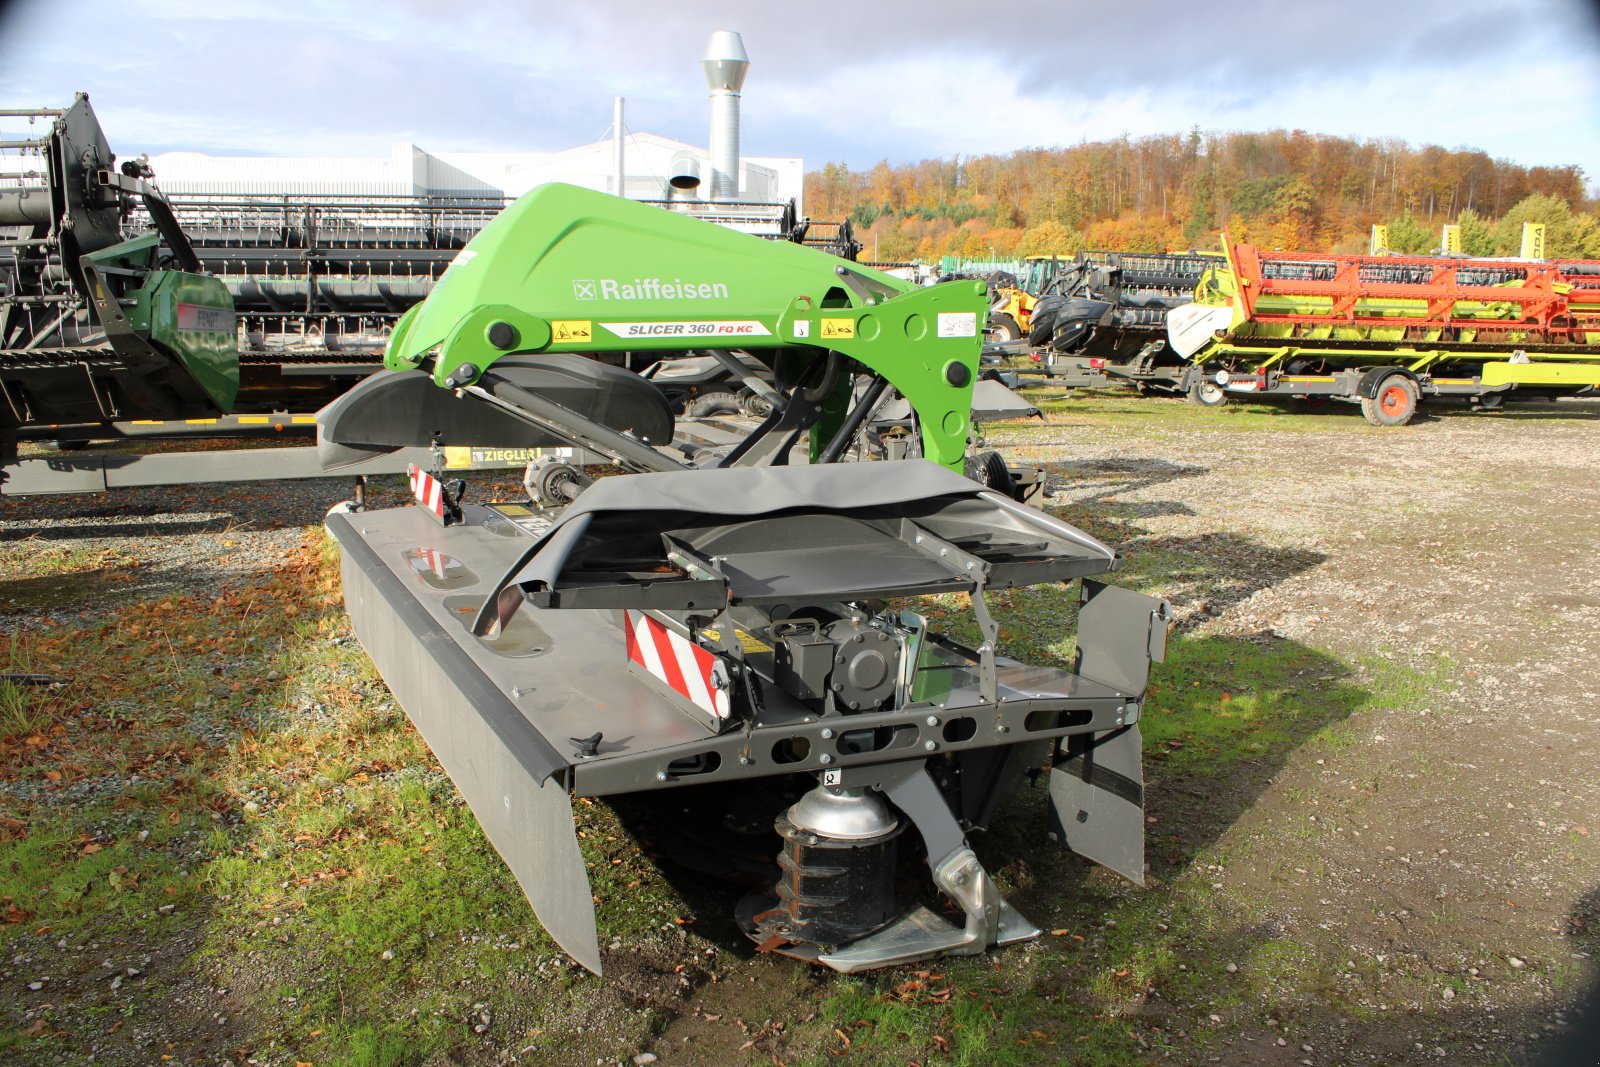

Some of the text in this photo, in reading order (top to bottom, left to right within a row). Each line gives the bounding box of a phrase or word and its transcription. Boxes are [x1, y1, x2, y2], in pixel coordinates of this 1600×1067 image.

[1534, 227, 1543, 260] OPA
[601, 278, 729, 300] Raiffeisen
[628, 324, 753, 335] SLICER 360 FQ KC
[485, 449, 535, 462] ZIEGLER
